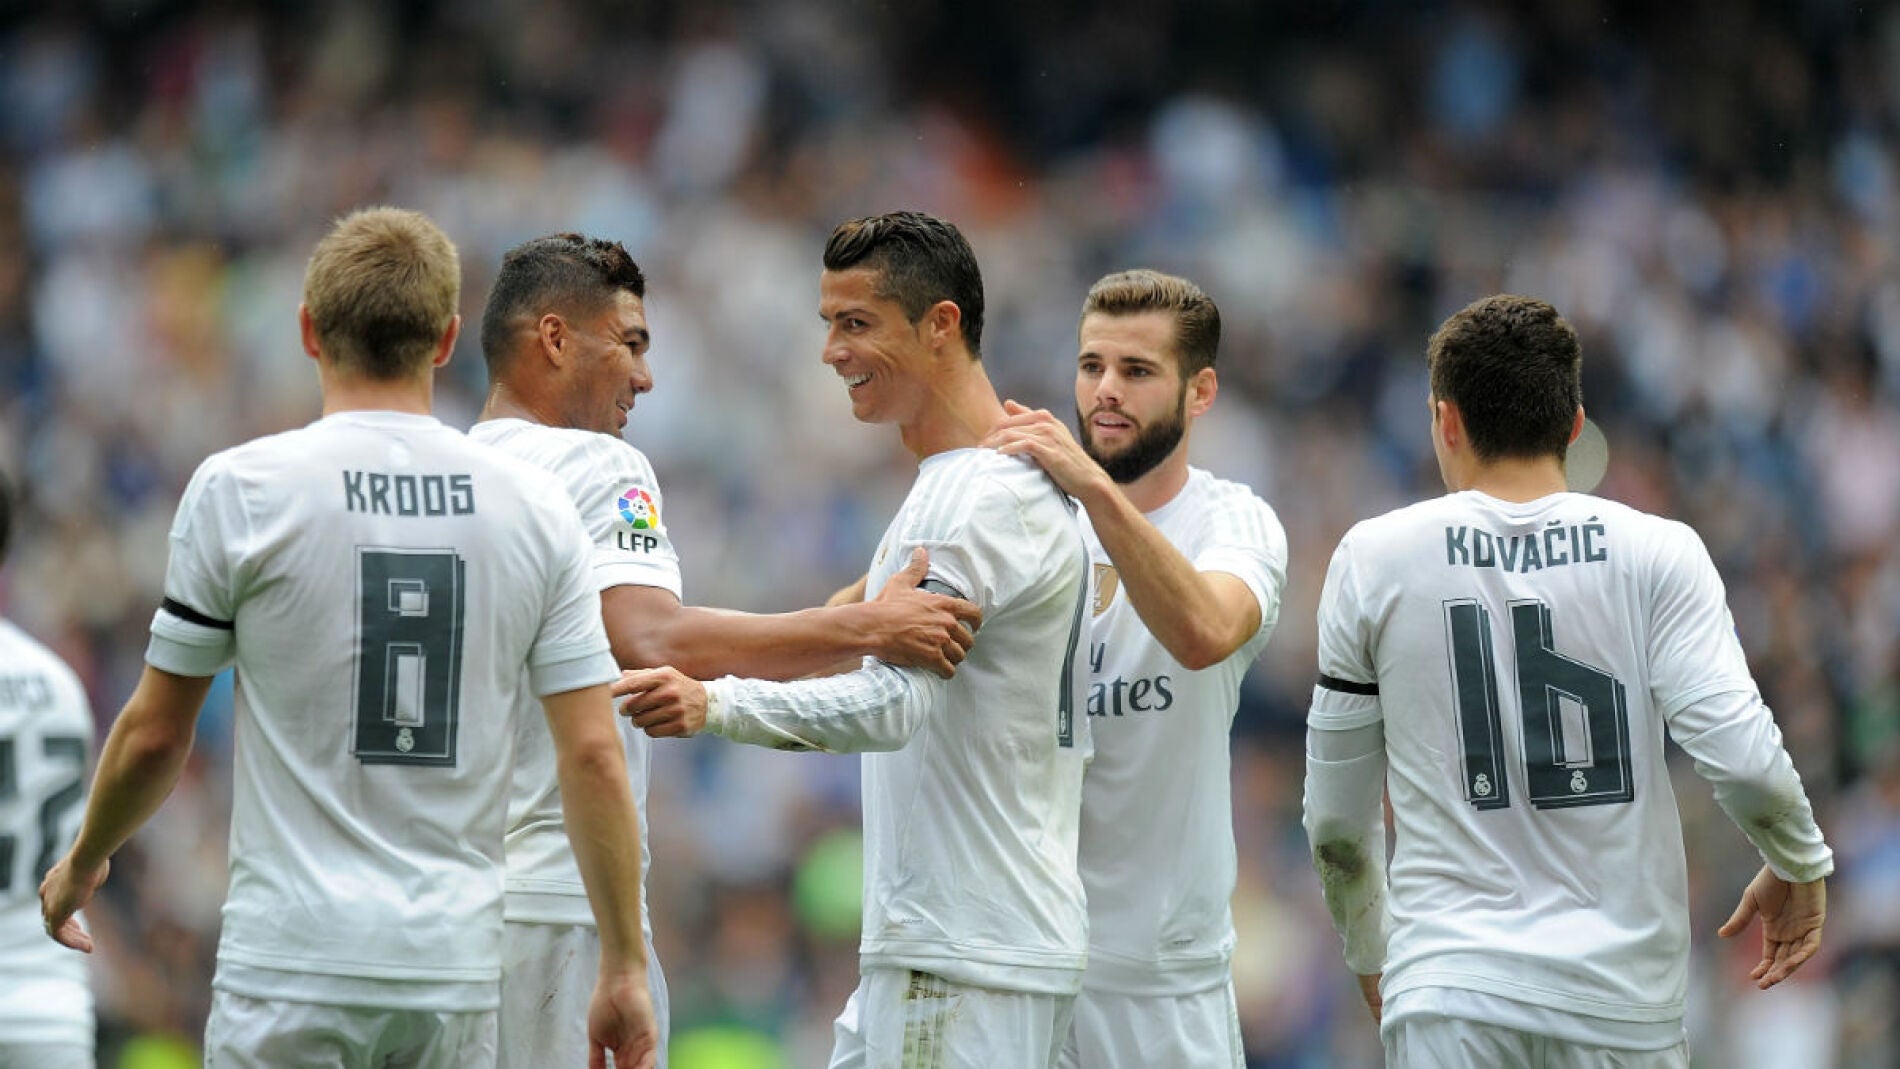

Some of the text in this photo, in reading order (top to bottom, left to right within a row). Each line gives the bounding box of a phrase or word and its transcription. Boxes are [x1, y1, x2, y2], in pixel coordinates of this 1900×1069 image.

[342, 470, 475, 516] KROOS
[617, 531, 658, 554] LFP
[1445, 515, 1607, 574] KOVAČIĆ
[349, 545, 466, 768] 8
[1443, 598, 1634, 811] 16
